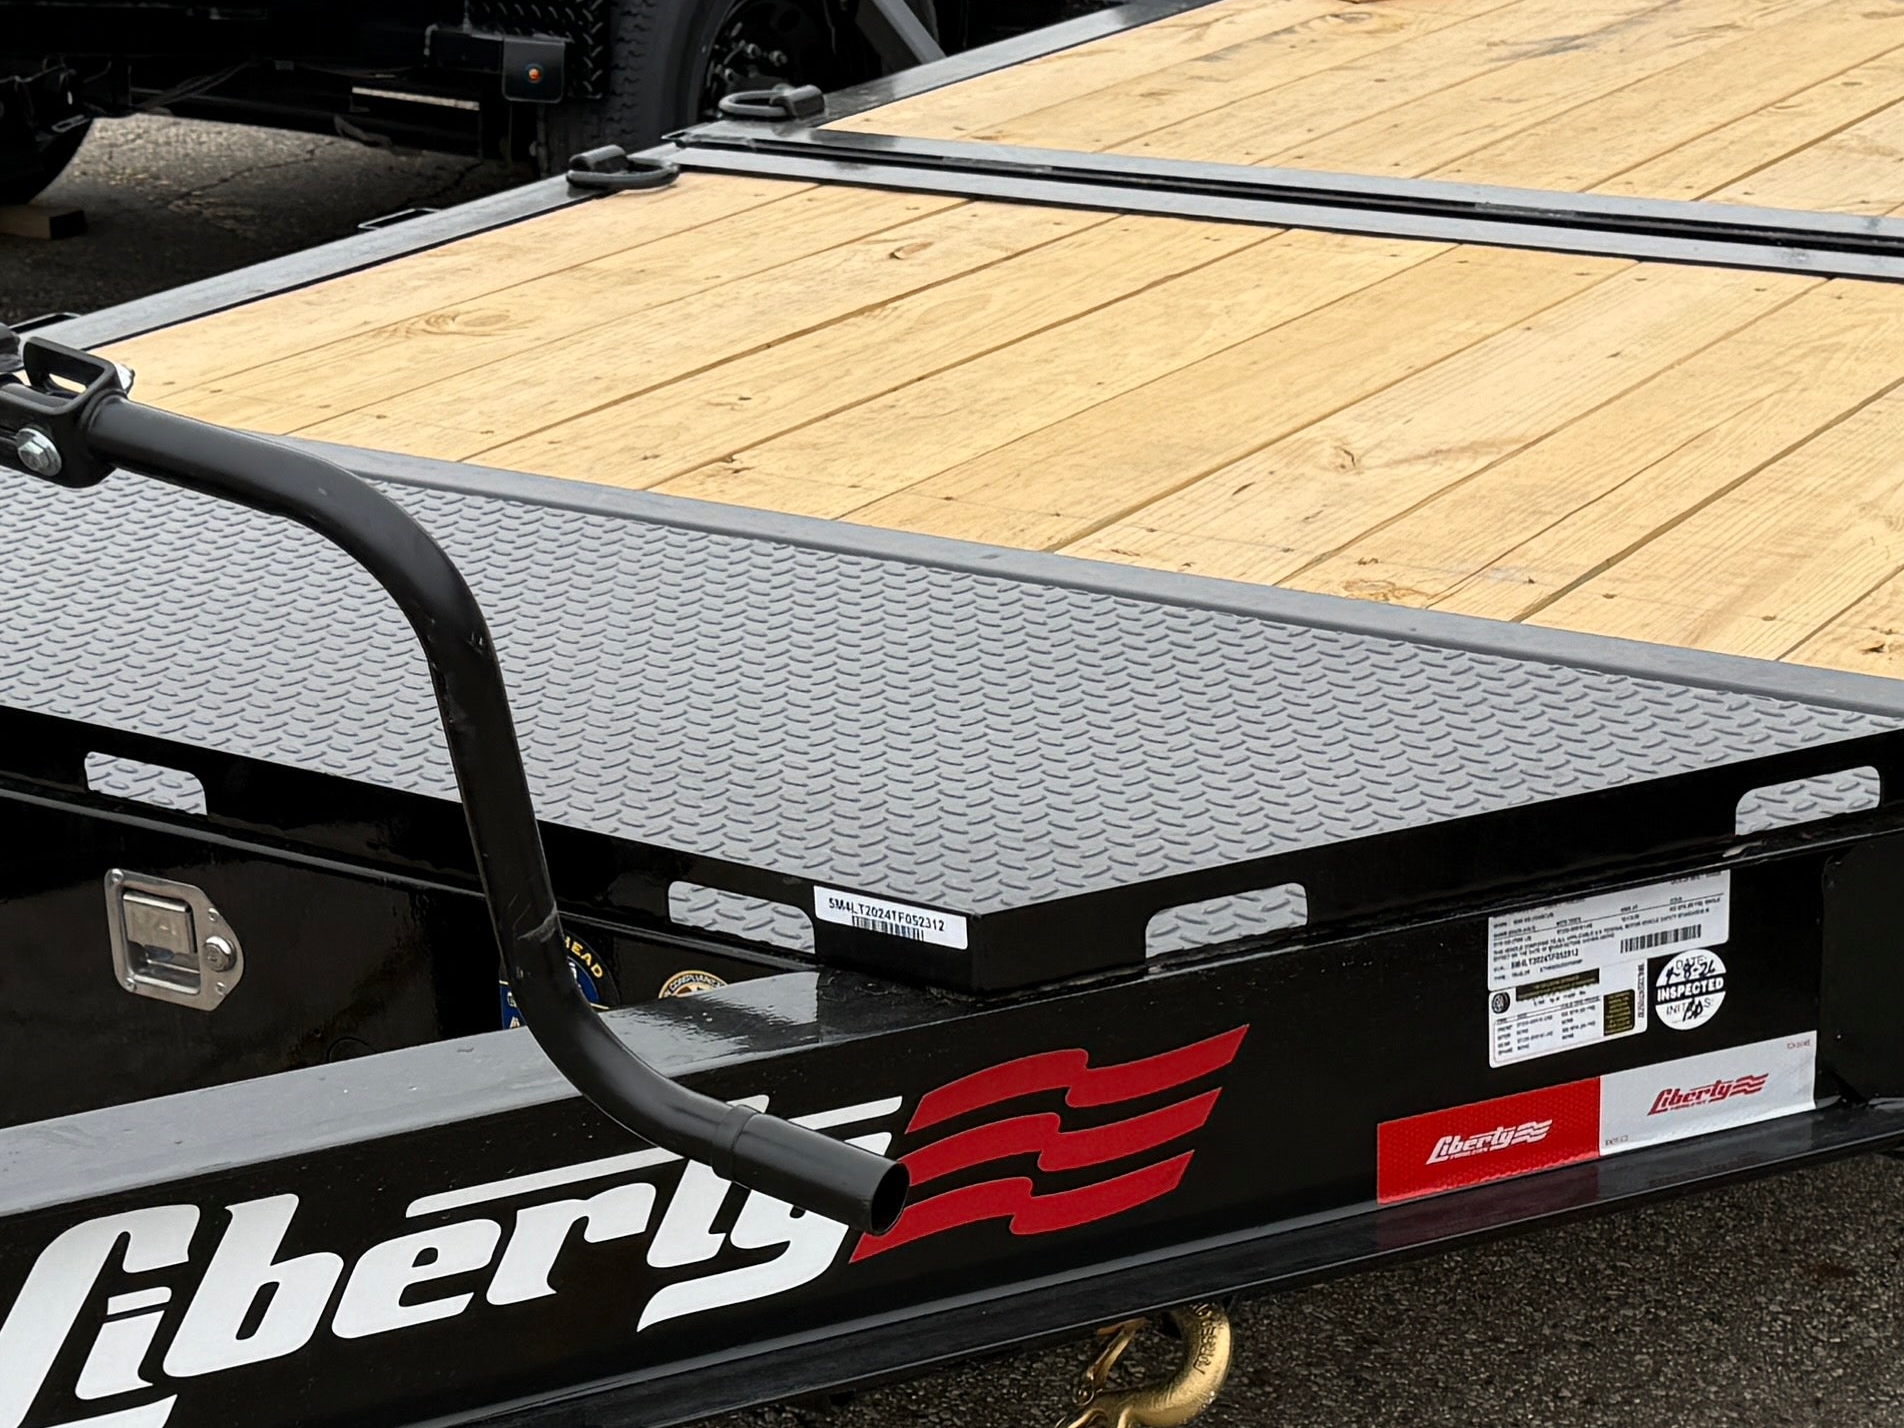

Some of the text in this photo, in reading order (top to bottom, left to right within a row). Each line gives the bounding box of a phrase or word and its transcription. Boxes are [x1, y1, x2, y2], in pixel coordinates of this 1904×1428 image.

[1657, 977, 1724, 1003] INSPECTED
[1647, 1080, 1734, 1116] Liberty
[1425, 1126, 1517, 1165] Liberty
